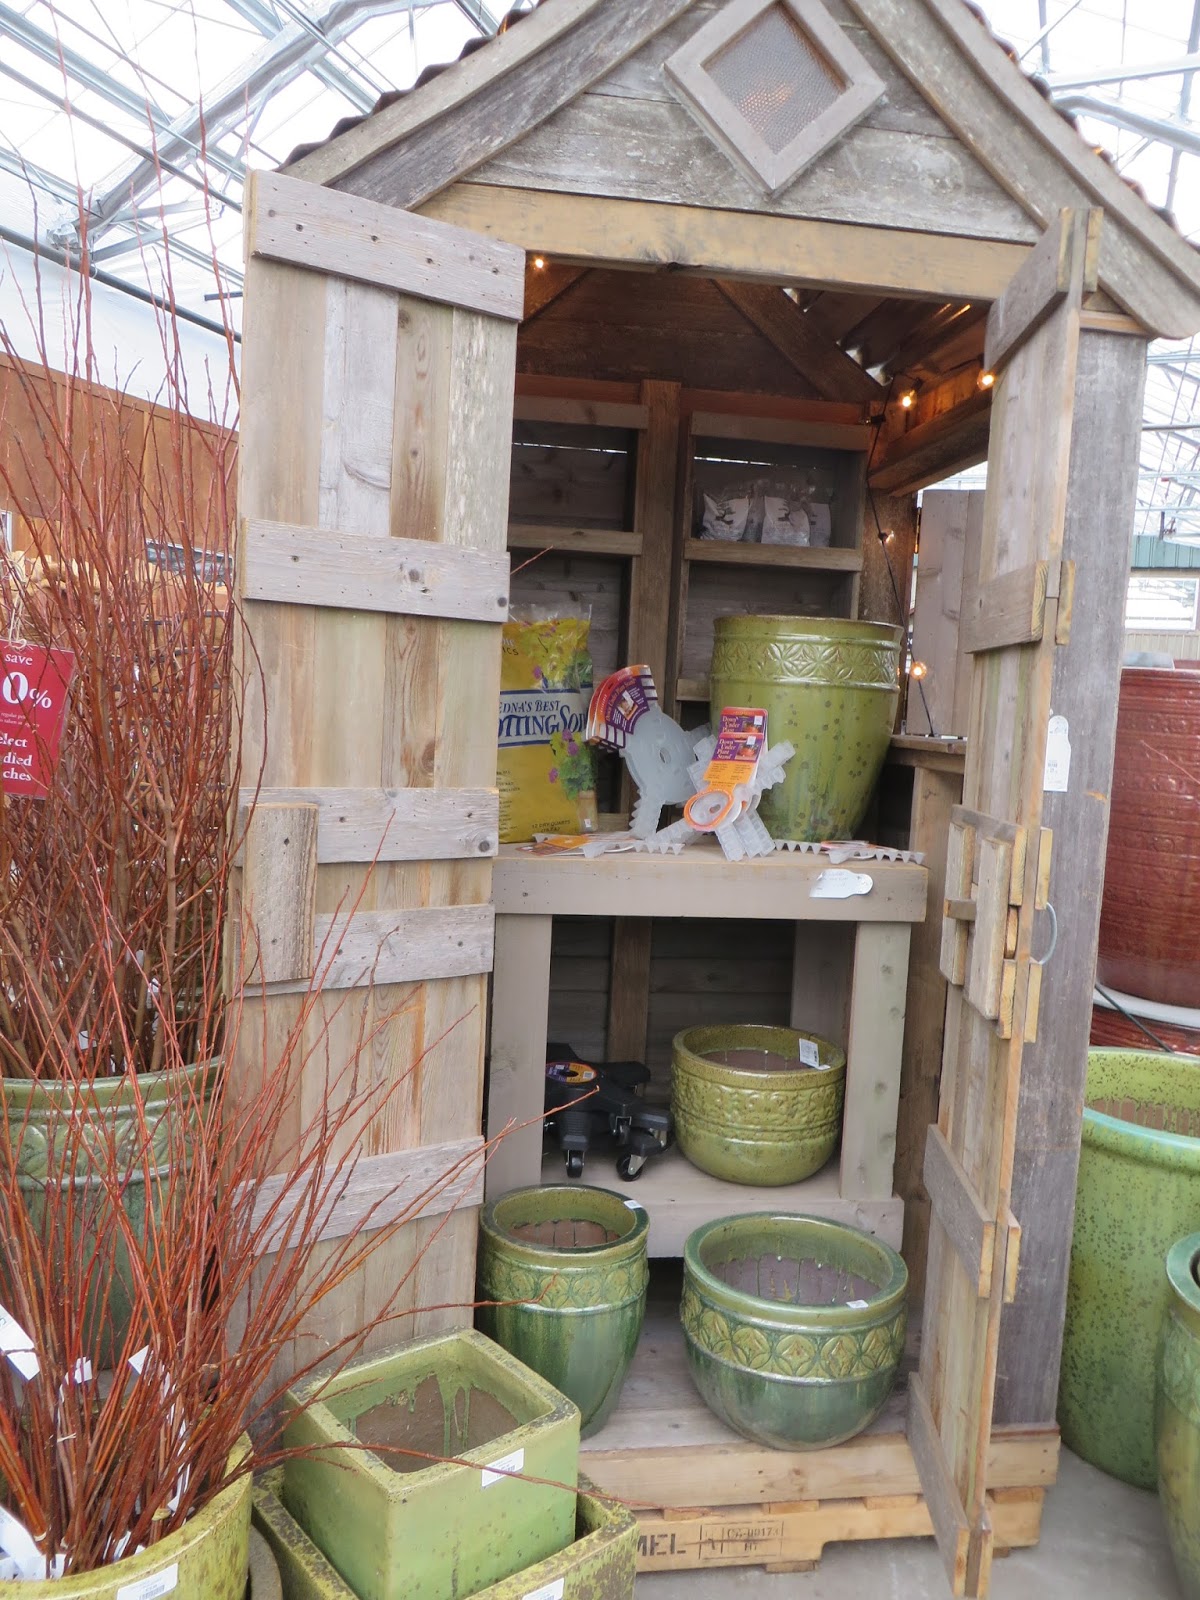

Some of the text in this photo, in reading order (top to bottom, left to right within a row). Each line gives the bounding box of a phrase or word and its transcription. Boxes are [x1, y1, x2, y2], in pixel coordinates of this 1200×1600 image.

[5, 653, 33, 666] save
[535, 699, 561, 712] BEST
[2, 768, 32, 781] ches
